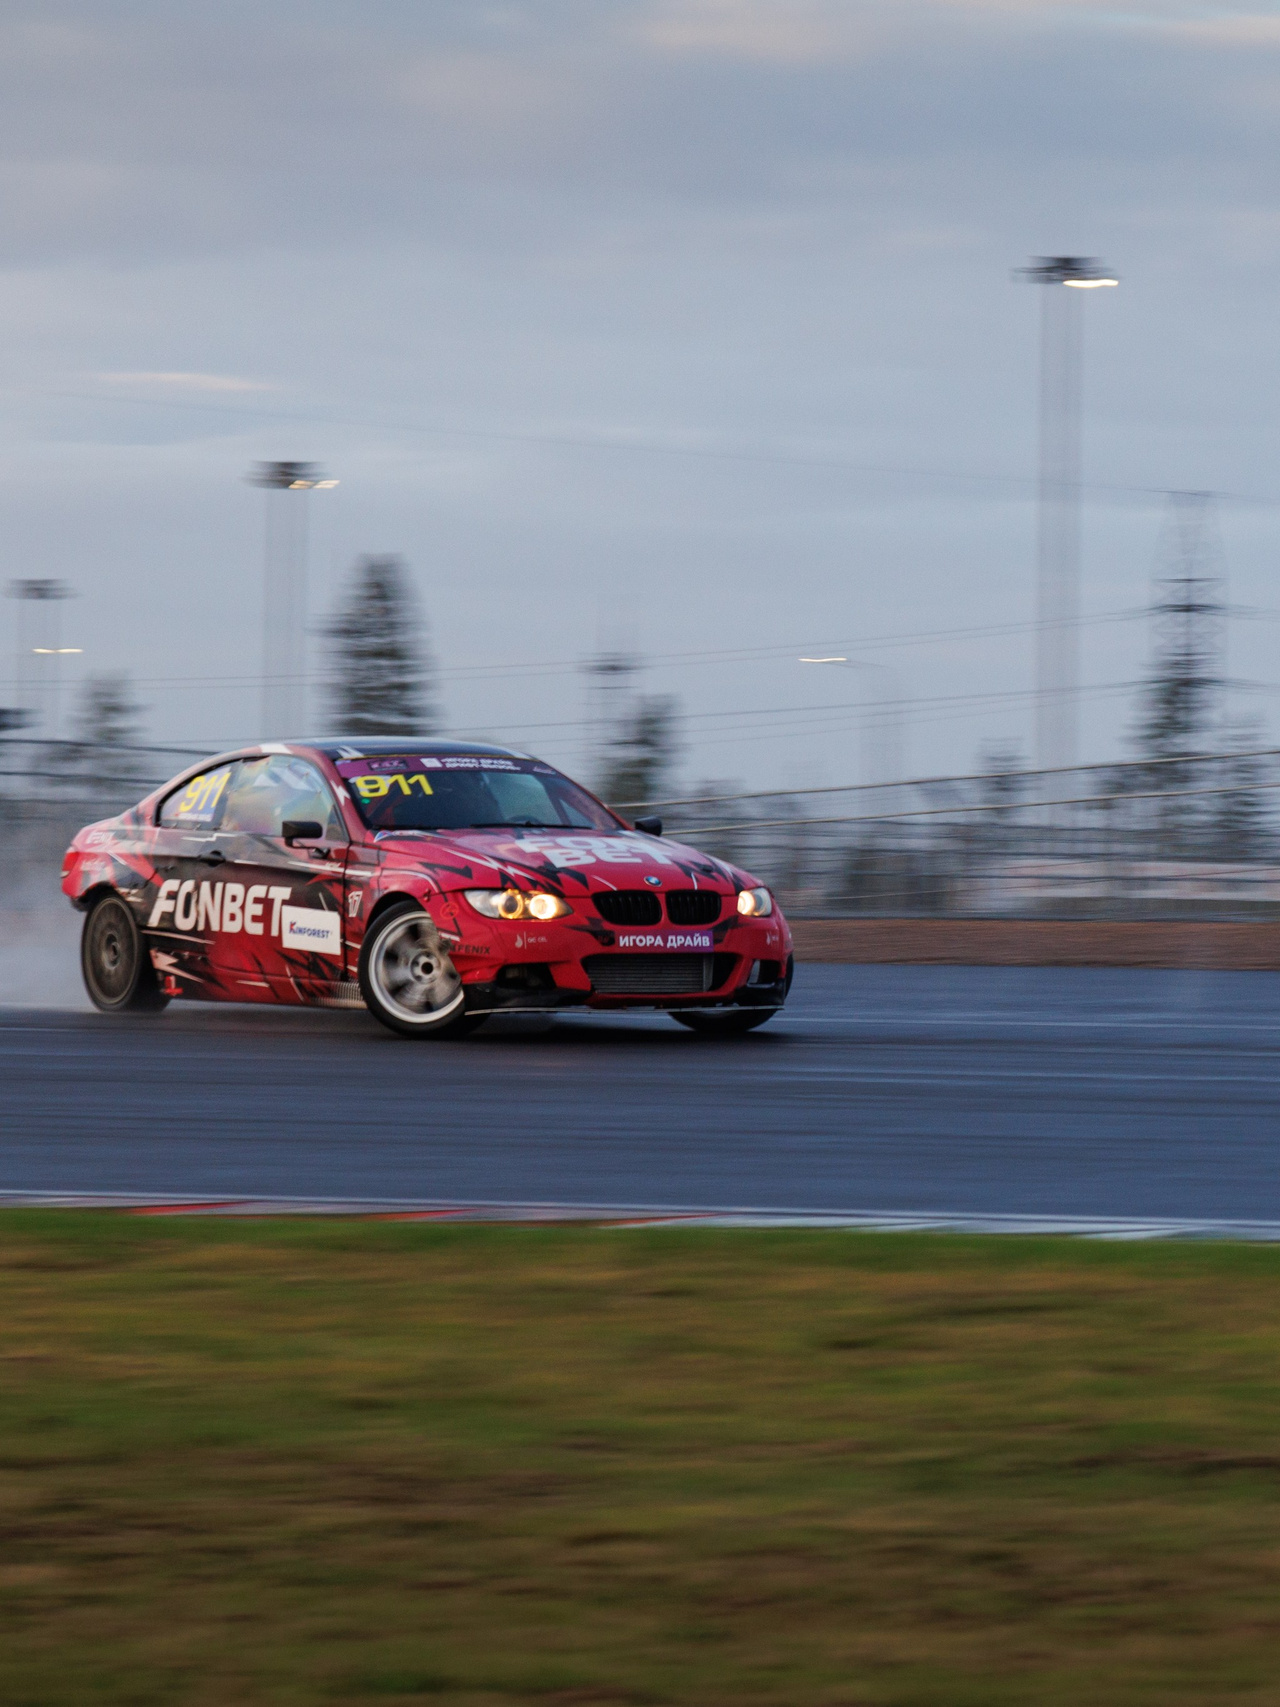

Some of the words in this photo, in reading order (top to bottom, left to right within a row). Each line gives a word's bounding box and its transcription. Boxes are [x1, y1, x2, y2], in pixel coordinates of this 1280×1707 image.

[179, 772, 232, 813] 911
[355, 774, 434, 798] 911
[542, 848, 672, 867] BET
[147, 879, 292, 937] FONBET
[619, 935, 664, 947] ИГОРА
[667, 933, 710, 948] ДРАЙВ
